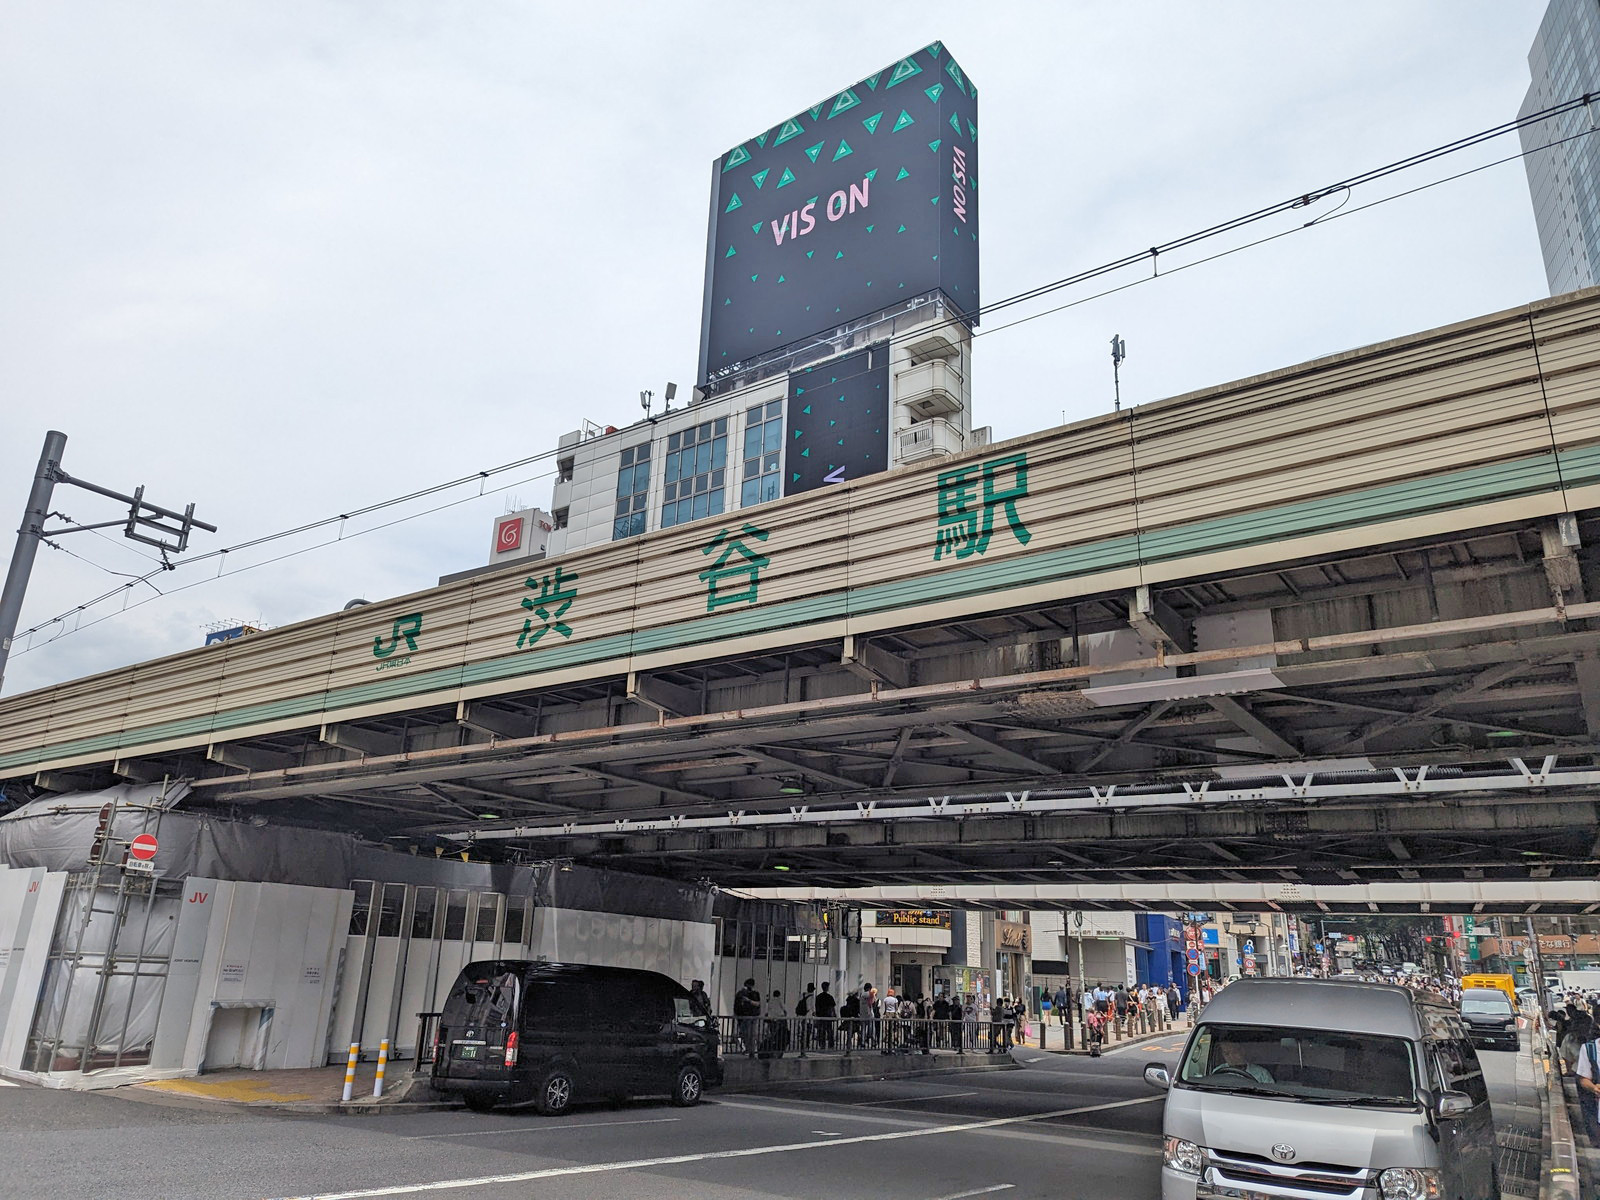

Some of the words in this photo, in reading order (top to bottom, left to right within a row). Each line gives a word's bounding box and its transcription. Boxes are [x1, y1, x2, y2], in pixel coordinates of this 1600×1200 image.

[373, 612, 423, 658] JR
[29, 881, 39, 892] JV
[189, 892, 209, 904] JV
[893, 913, 917, 924] Public
[919, 916, 940, 924] stand
